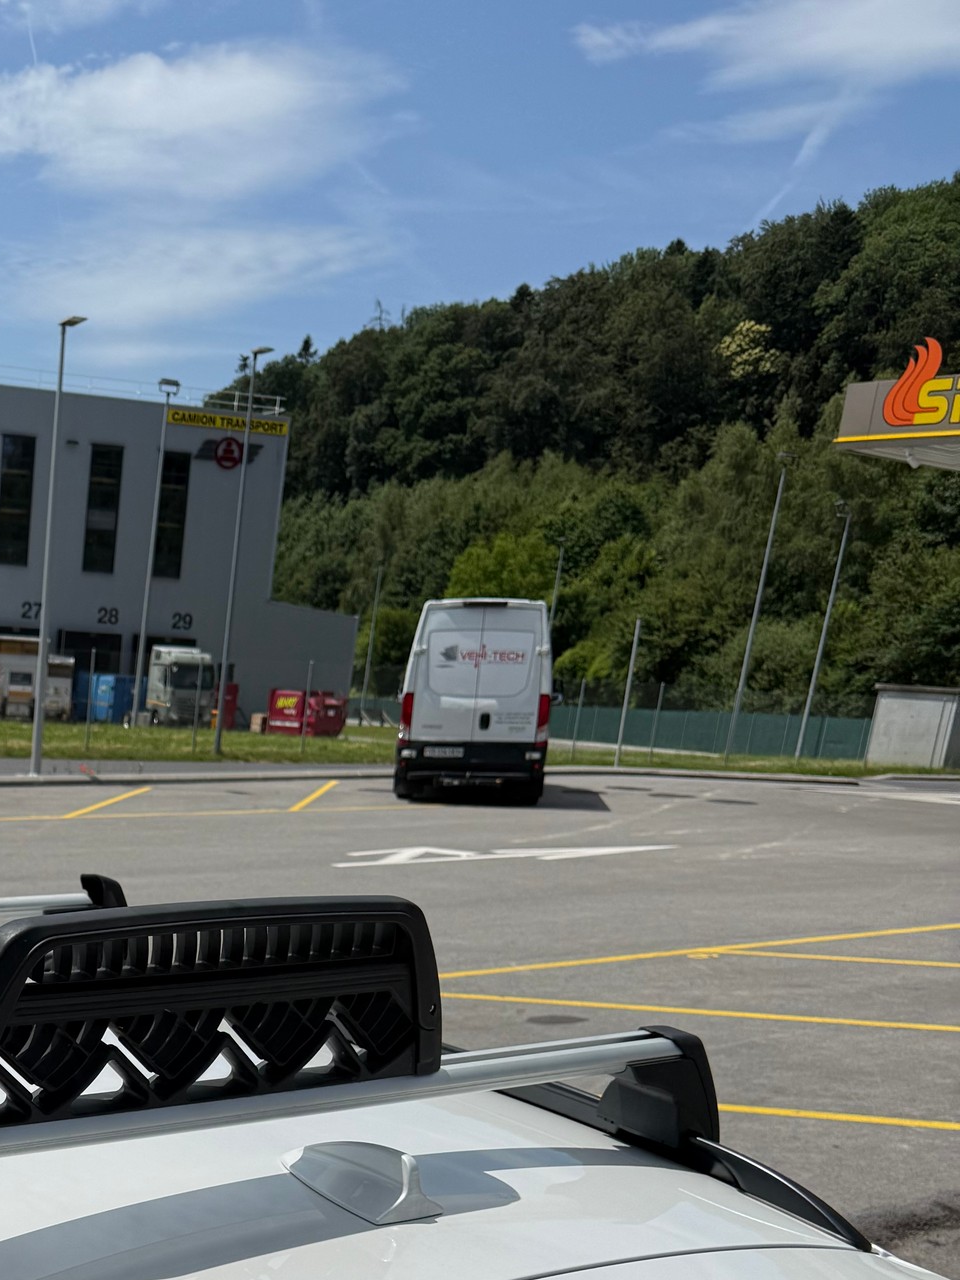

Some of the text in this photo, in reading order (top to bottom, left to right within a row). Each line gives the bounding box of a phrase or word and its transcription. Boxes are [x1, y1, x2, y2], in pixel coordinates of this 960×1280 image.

[171, 411, 217, 427] CAMION
[21, 601, 42, 620] 27
[97, 607, 119, 625] 28
[171, 612, 193, 630] 29
